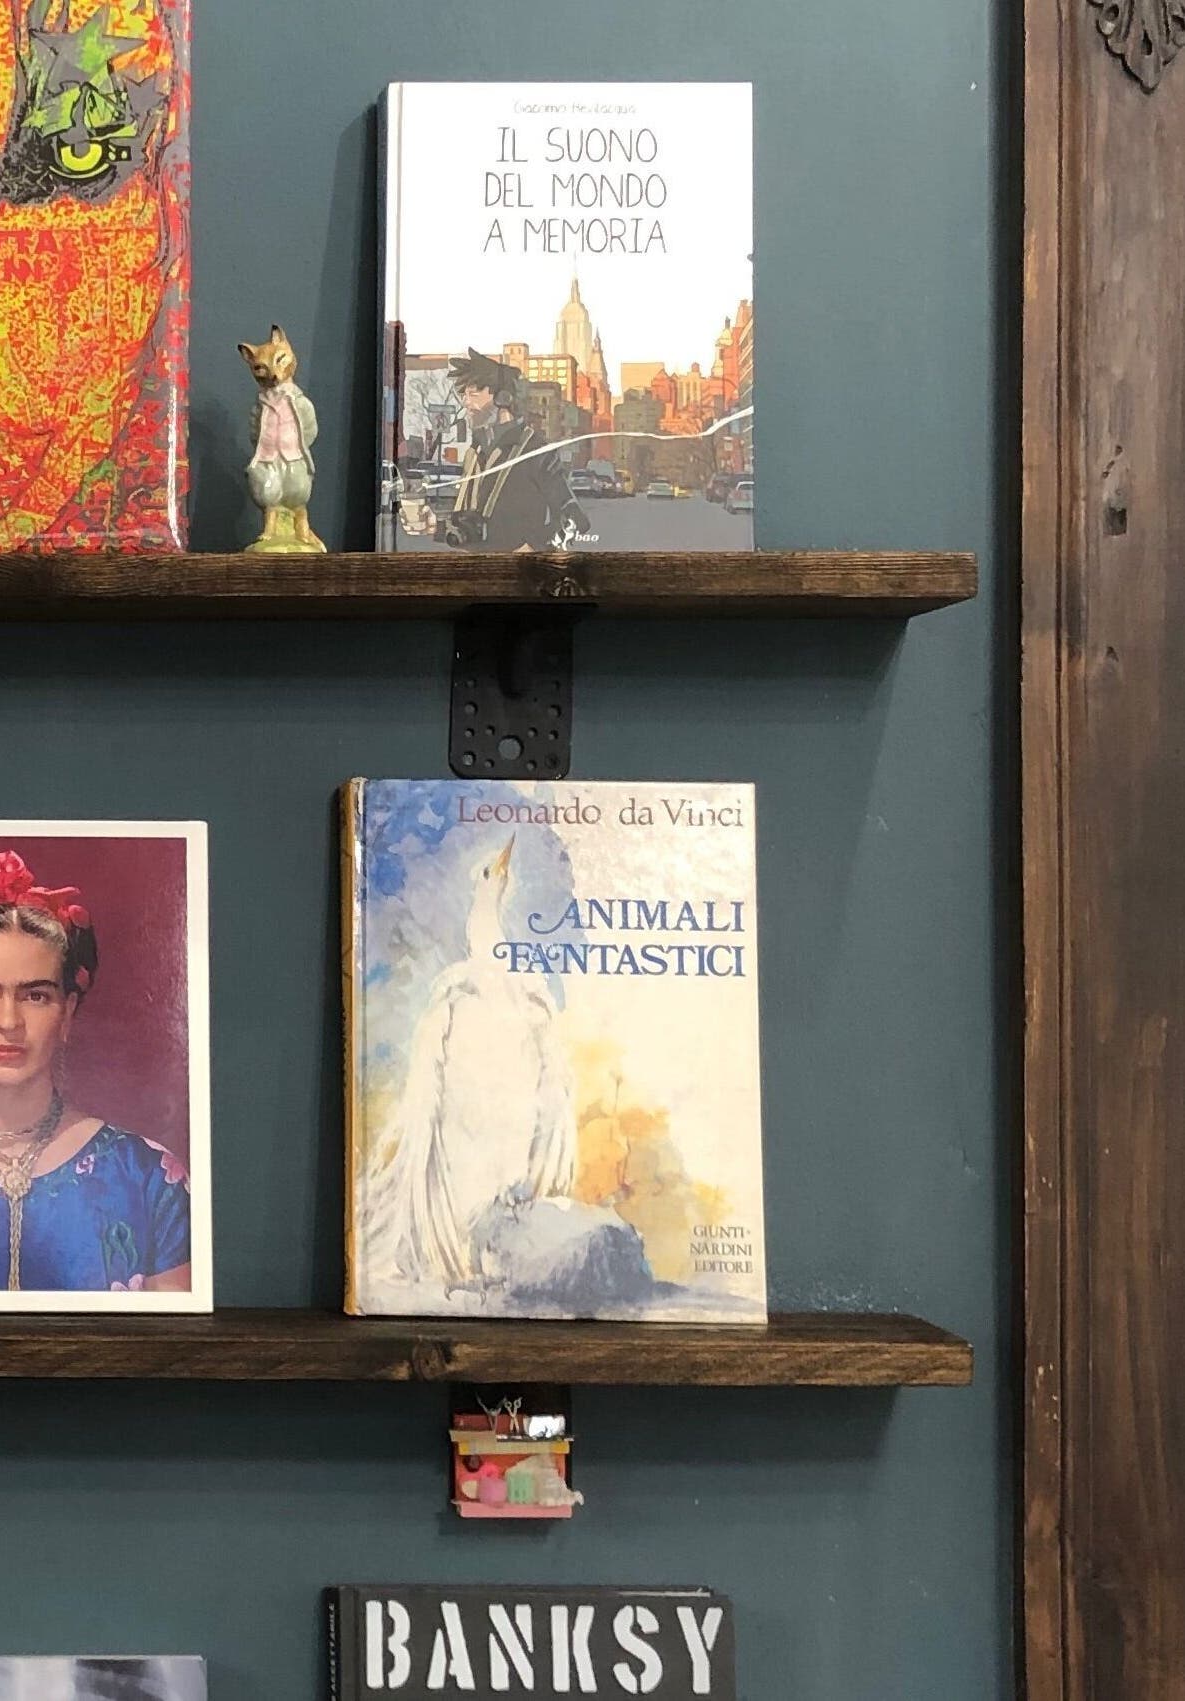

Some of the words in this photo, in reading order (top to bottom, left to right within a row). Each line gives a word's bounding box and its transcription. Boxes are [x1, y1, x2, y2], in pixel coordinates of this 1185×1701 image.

[496, 126, 528, 163] IL
[545, 127, 658, 163] SUONO
[484, 172, 534, 208] DEL
[552, 172, 667, 209] MONDO
[483, 218, 506, 253] A
[522, 218, 667, 254] MEMORIA
[457, 796, 602, 826] Leonardo
[619, 797, 654, 827] da
[661, 798, 744, 828] Vinci
[528, 899, 745, 934] ANIMALI
[493, 941, 746, 977] FANTASTICI
[689, 1242, 753, 1257] NARDINI
[694, 1260, 753, 1274] EDITORE
[365, 1599, 724, 1695] BANKSY
